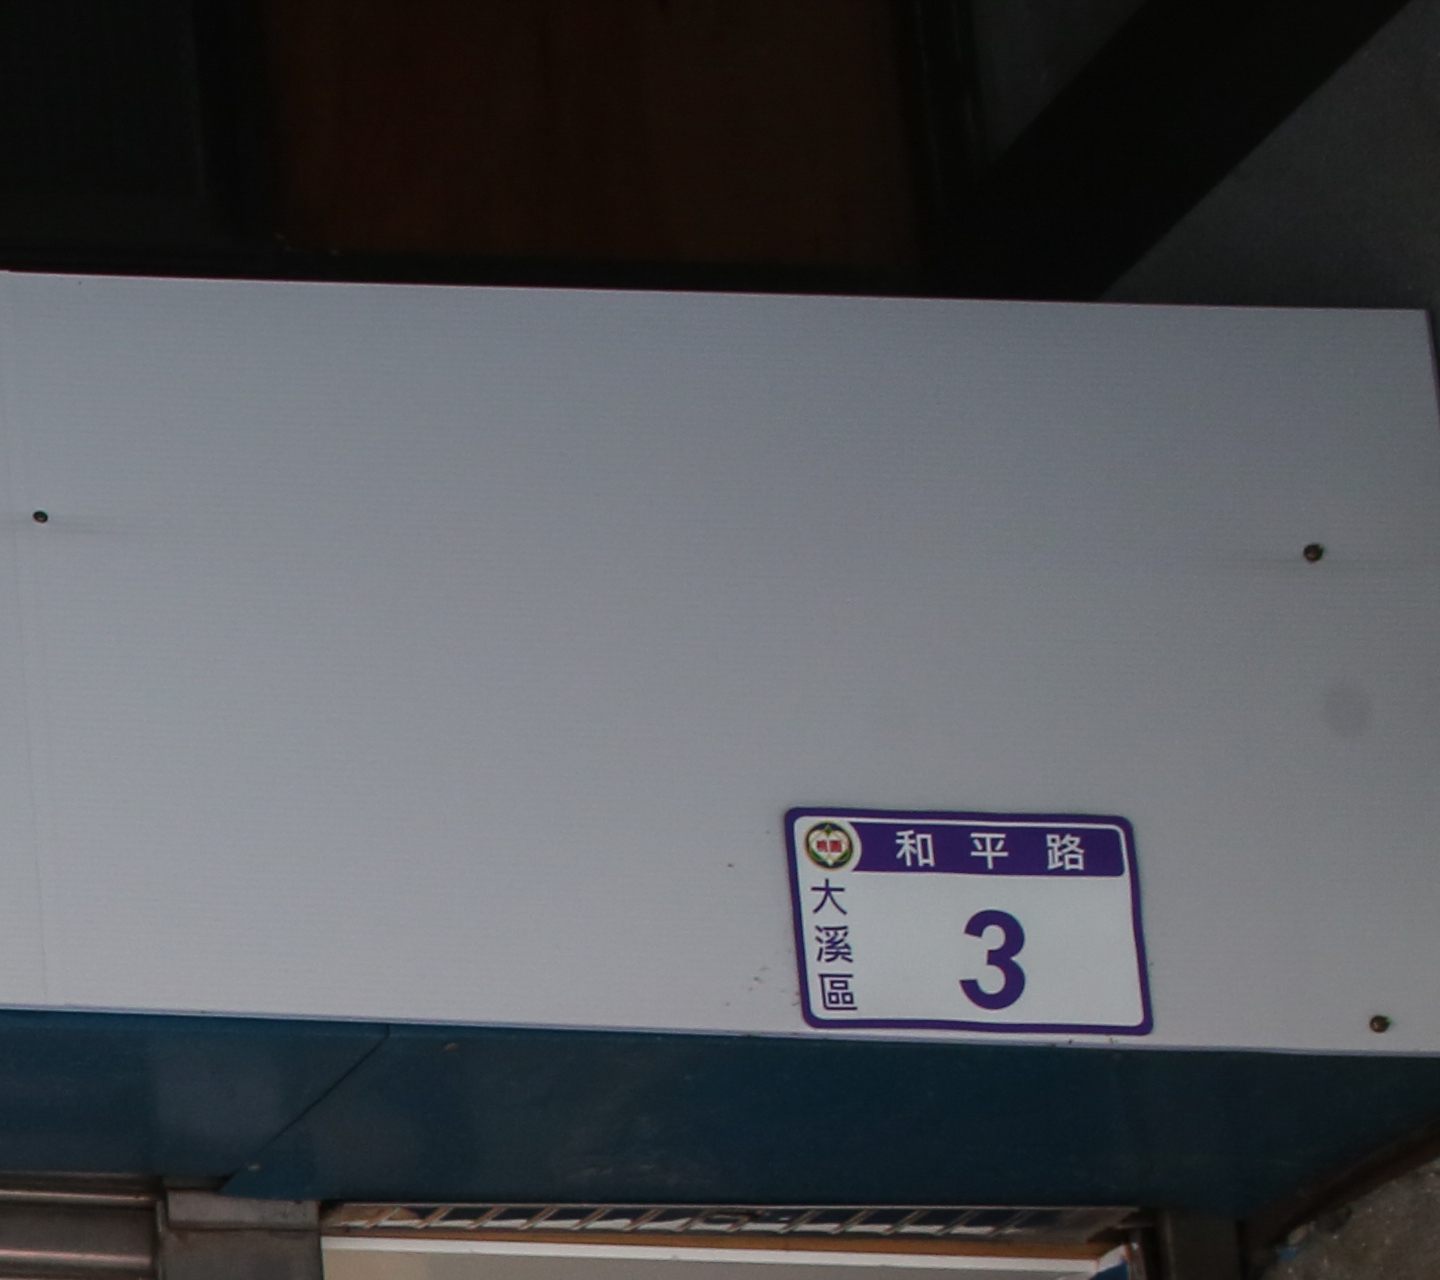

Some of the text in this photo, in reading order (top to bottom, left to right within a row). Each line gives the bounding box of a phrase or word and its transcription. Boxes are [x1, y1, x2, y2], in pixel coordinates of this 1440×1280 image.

[894, 830, 1085, 871] 和平路
[810, 878, 858, 1011] 大溪區
[959, 909, 1026, 1010] 3
